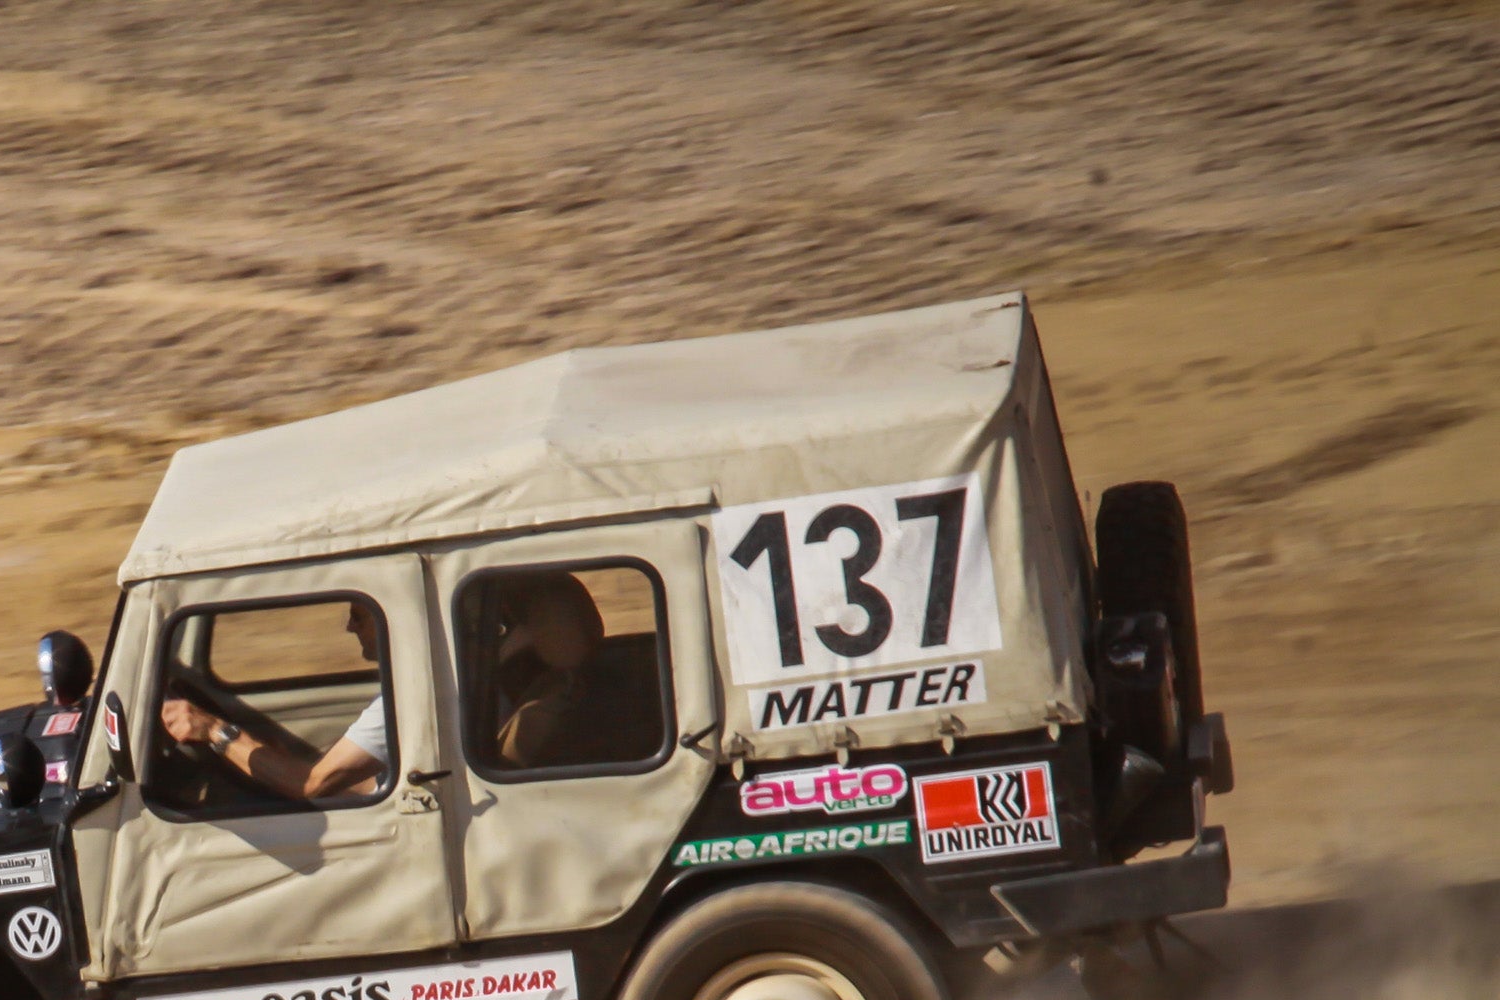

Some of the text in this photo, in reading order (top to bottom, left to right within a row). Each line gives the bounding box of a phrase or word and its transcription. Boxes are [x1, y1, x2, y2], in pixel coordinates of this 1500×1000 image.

[729, 487, 969, 668] 137
[759, 663, 975, 728] MATTER
[745, 768, 906, 811] auto
[823, 794, 893, 812] verte
[674, 821, 909, 866] AIR AFRIQUE
[928, 820, 1052, 854] UNIROYAL
[10, 908, 60, 958] VW
[482, 970, 557, 995] DAKAR
